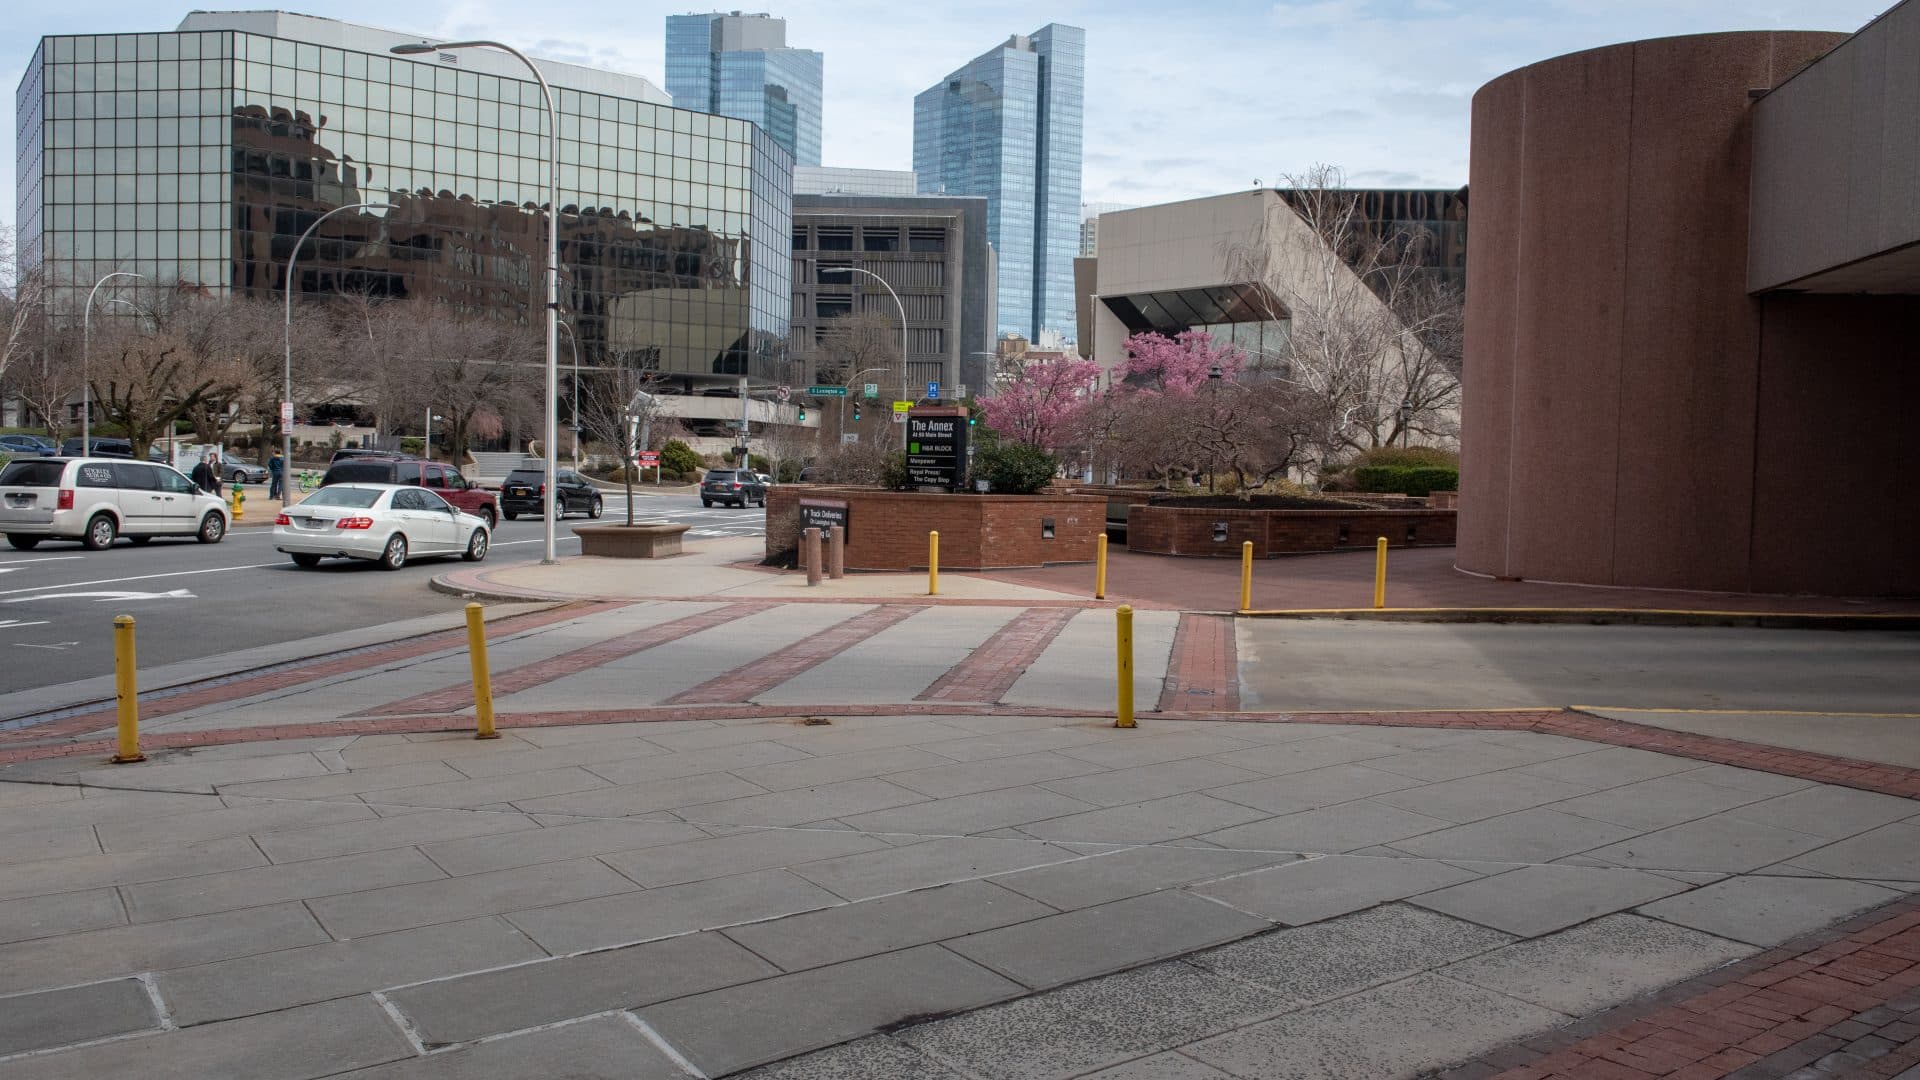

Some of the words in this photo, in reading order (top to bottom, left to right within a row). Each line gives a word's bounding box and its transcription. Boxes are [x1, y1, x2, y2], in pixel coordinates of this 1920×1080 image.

[816, 388, 839, 396] Lexington
[929, 384, 938, 392] H
[911, 420, 926, 432] The
[928, 420, 954, 432] Annex
[810, 509, 821, 518] Truck
[821, 510, 843, 520] Deliveries
